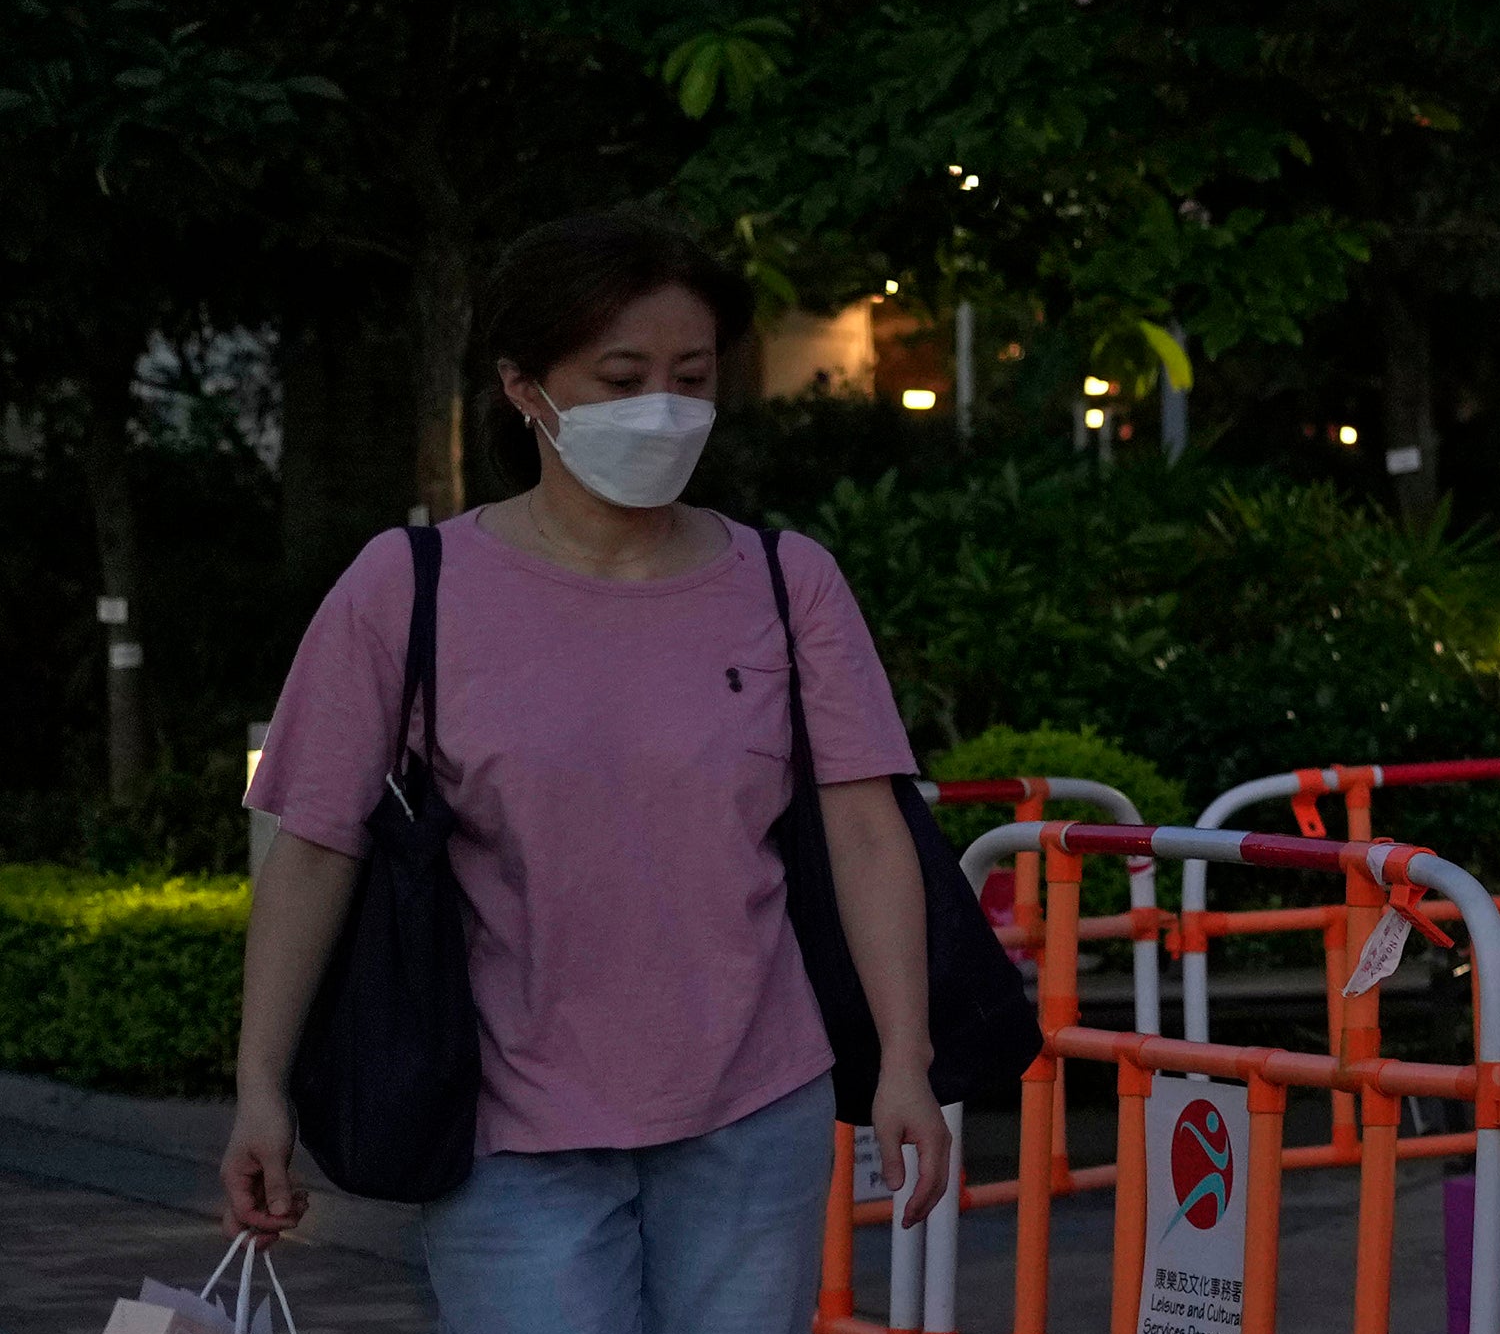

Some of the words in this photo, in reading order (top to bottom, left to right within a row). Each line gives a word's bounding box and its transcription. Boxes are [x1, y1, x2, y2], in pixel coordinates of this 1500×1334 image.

[1155, 1268, 1242, 1303] 康樂及文化事務署
[1151, 1293, 1185, 1316] Leisure
[1187, 1302, 1206, 1320] and
